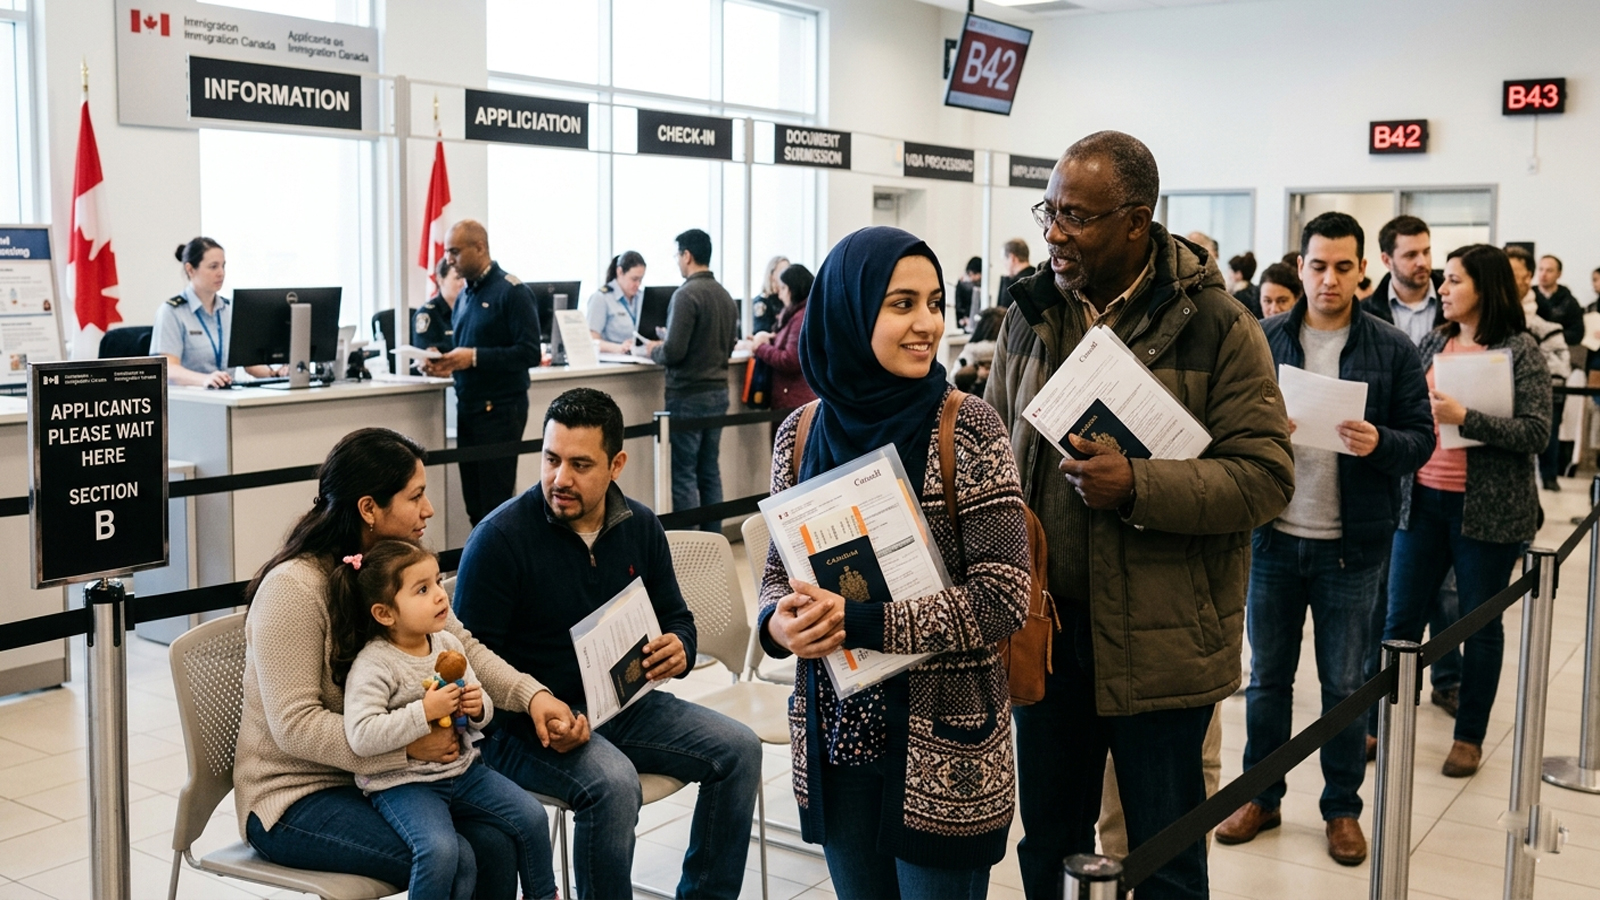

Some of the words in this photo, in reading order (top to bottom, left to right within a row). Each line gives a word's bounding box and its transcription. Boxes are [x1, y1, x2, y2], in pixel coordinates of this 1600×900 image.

[962, 40, 1017, 92] B42
[204, 77, 350, 112] INFORMATION
[1507, 84, 1559, 109] B43
[475, 106, 581, 134] APPLICIATION
[657, 124, 716, 146] CHECK-IN
[1373, 124, 1421, 149] B42
[50, 397, 152, 421] APPLICANTS
[48, 424, 112, 446] PLEASE
[115, 420, 155, 440] WAIT
[81, 447, 126, 467] HERE
[69, 481, 138, 505] SECTION
[95, 509, 116, 541] B
